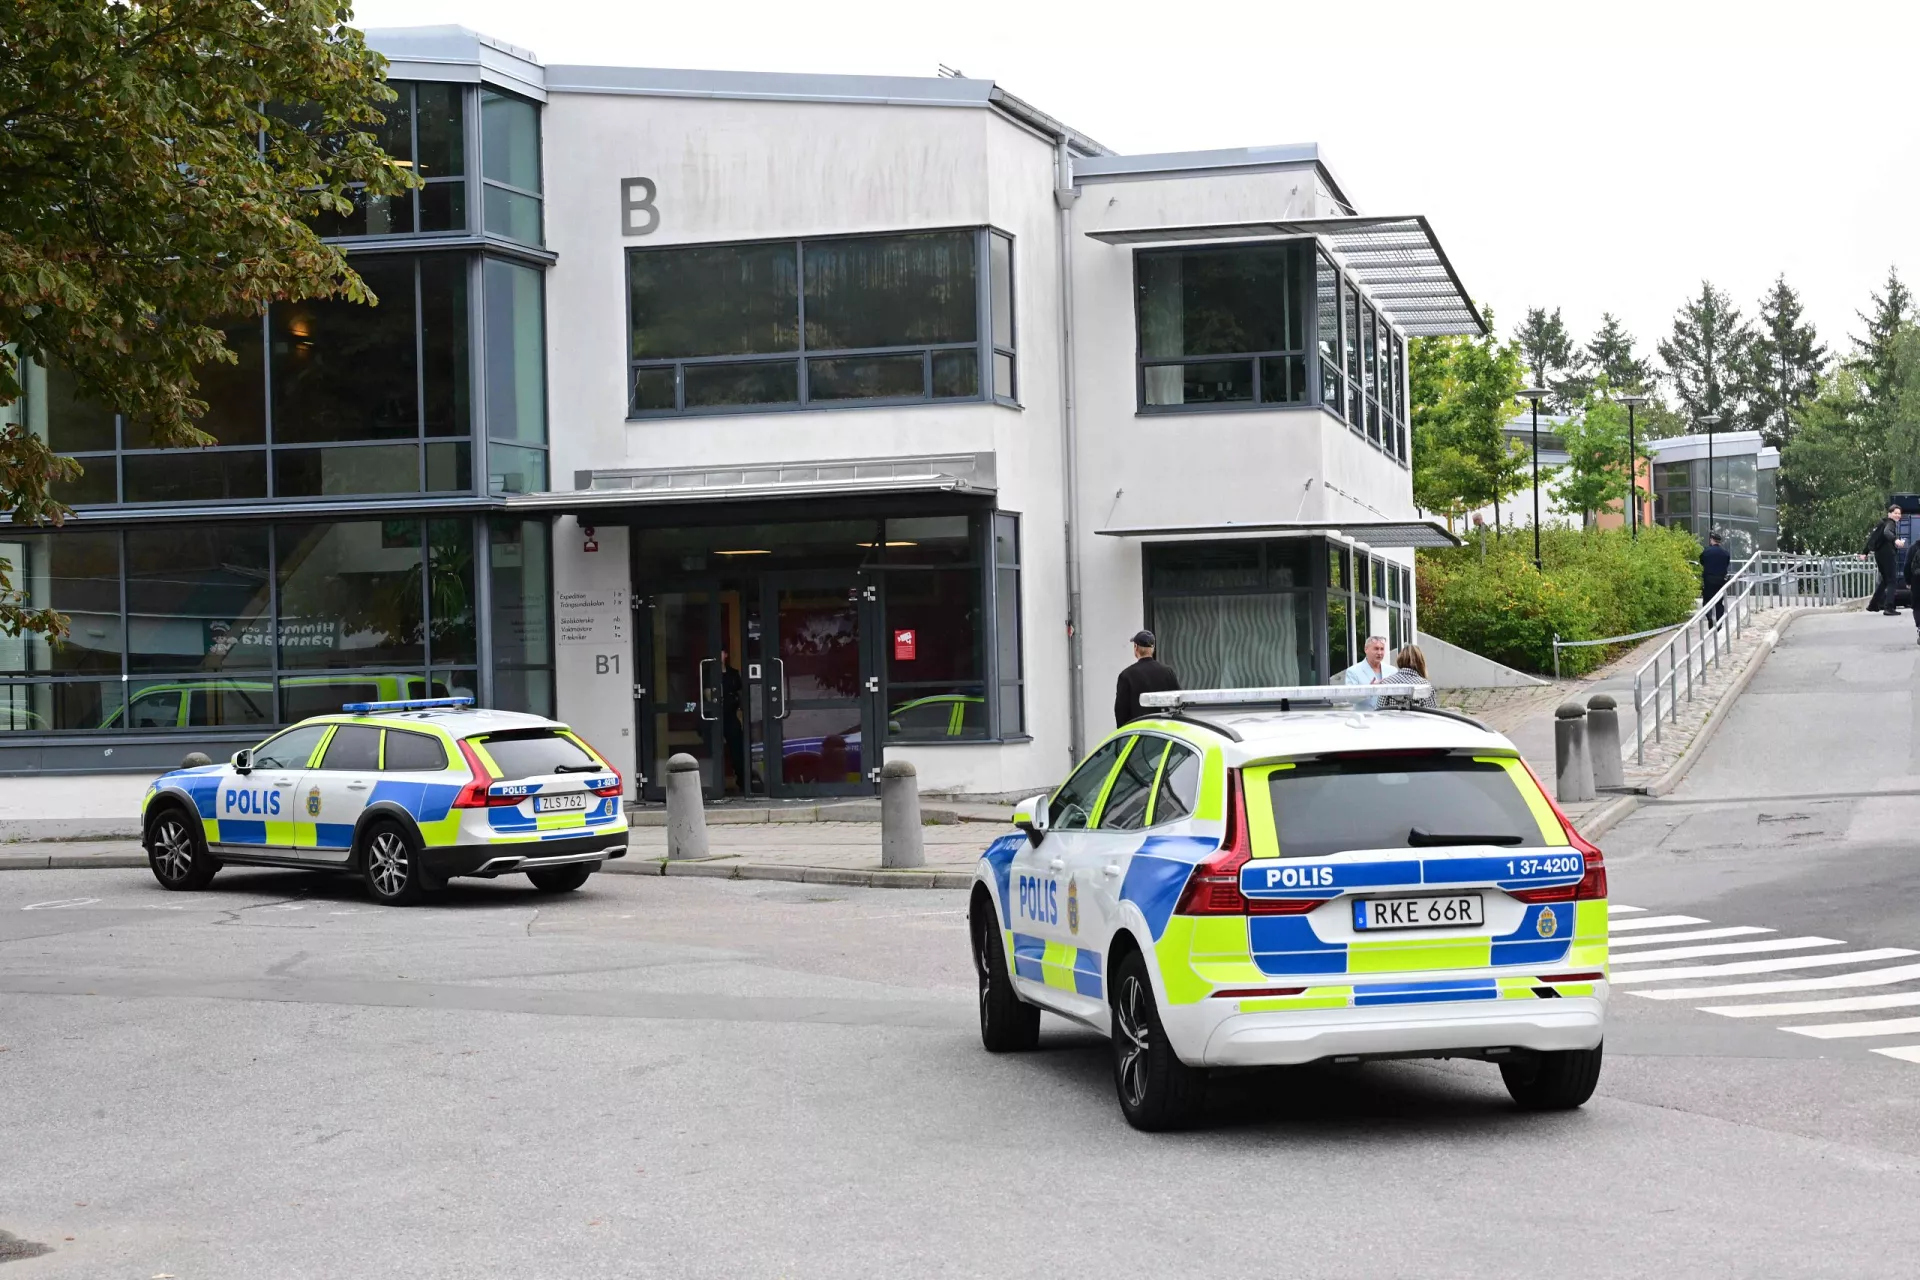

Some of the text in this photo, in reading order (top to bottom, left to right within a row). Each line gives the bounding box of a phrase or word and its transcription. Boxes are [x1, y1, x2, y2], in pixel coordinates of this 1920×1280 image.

[621, 176, 660, 236] B
[595, 654, 620, 675] B1
[502, 786, 527, 795] POLIS
[226, 789, 280, 815] POLIS
[543, 797, 561, 809] ZLS
[564, 795, 582, 807] 762
[1507, 857, 1579, 875] 1 37-4200
[1266, 867, 1334, 888] POLIS
[1020, 875, 1058, 926] POLIS
[1374, 899, 1472, 924] RKE 66R
